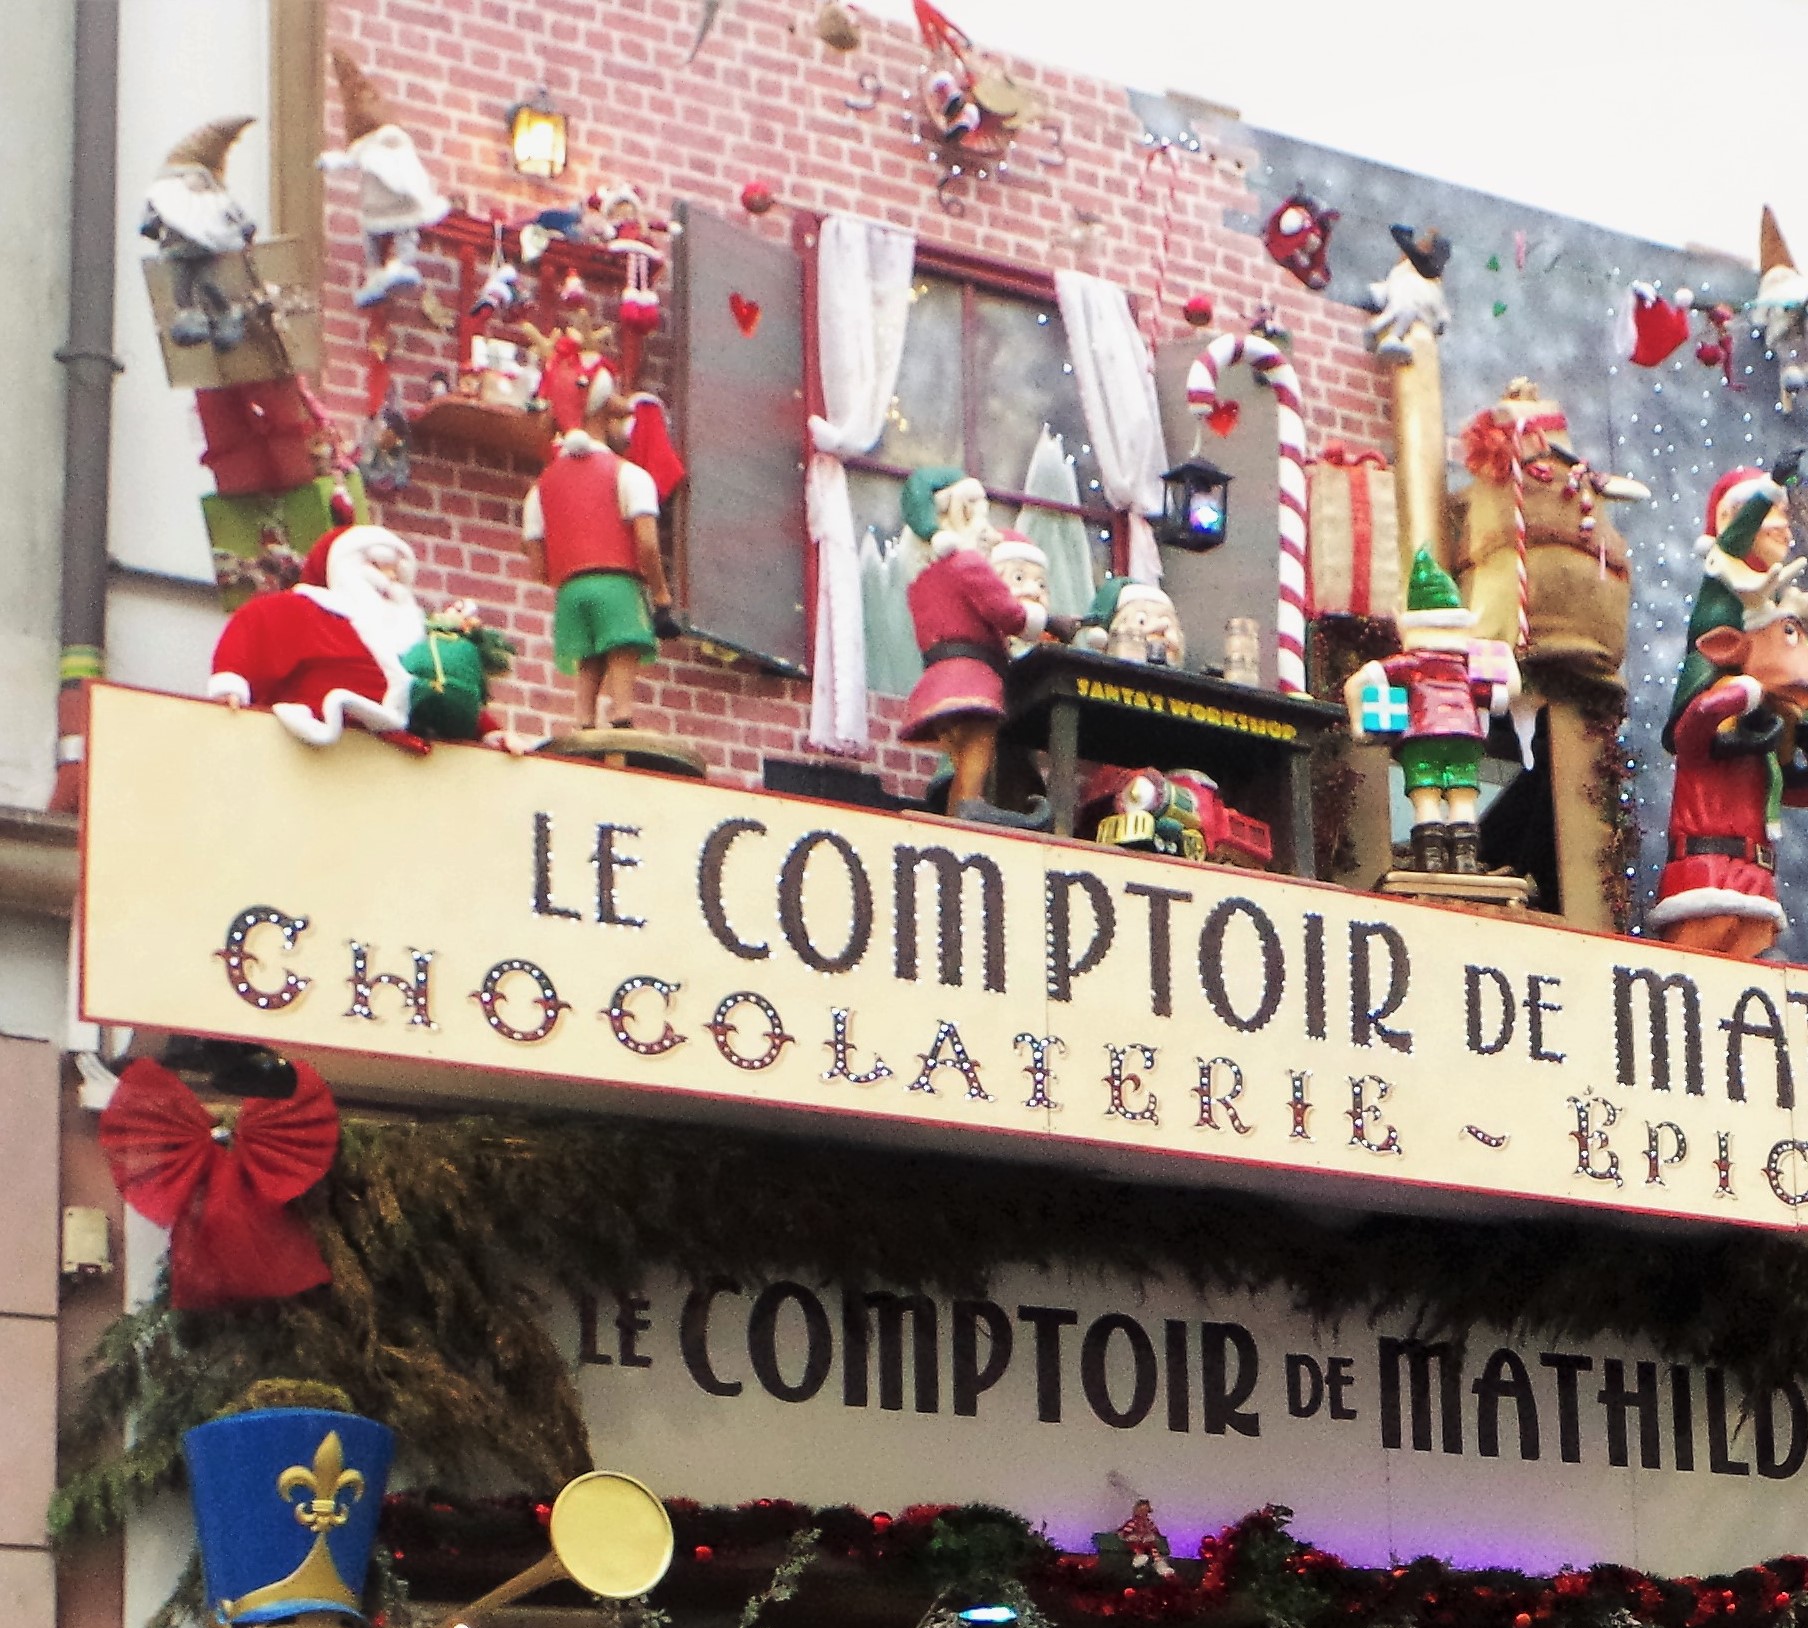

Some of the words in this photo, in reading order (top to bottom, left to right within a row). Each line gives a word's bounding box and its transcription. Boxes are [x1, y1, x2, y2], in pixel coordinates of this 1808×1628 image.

[1168, 698, 1297, 740] WORKSHOP
[212, 904, 1405, 1157] CHOCOLATERIE
[531, 811, 648, 927] LE
[694, 815, 1414, 1055] COMPTOIR
[1463, 964, 1567, 1064] DE
[577, 1294, 652, 1369] LE
[680, 1280, 1260, 1437] COMPTOIR
[1285, 1353, 1357, 1421] DE
